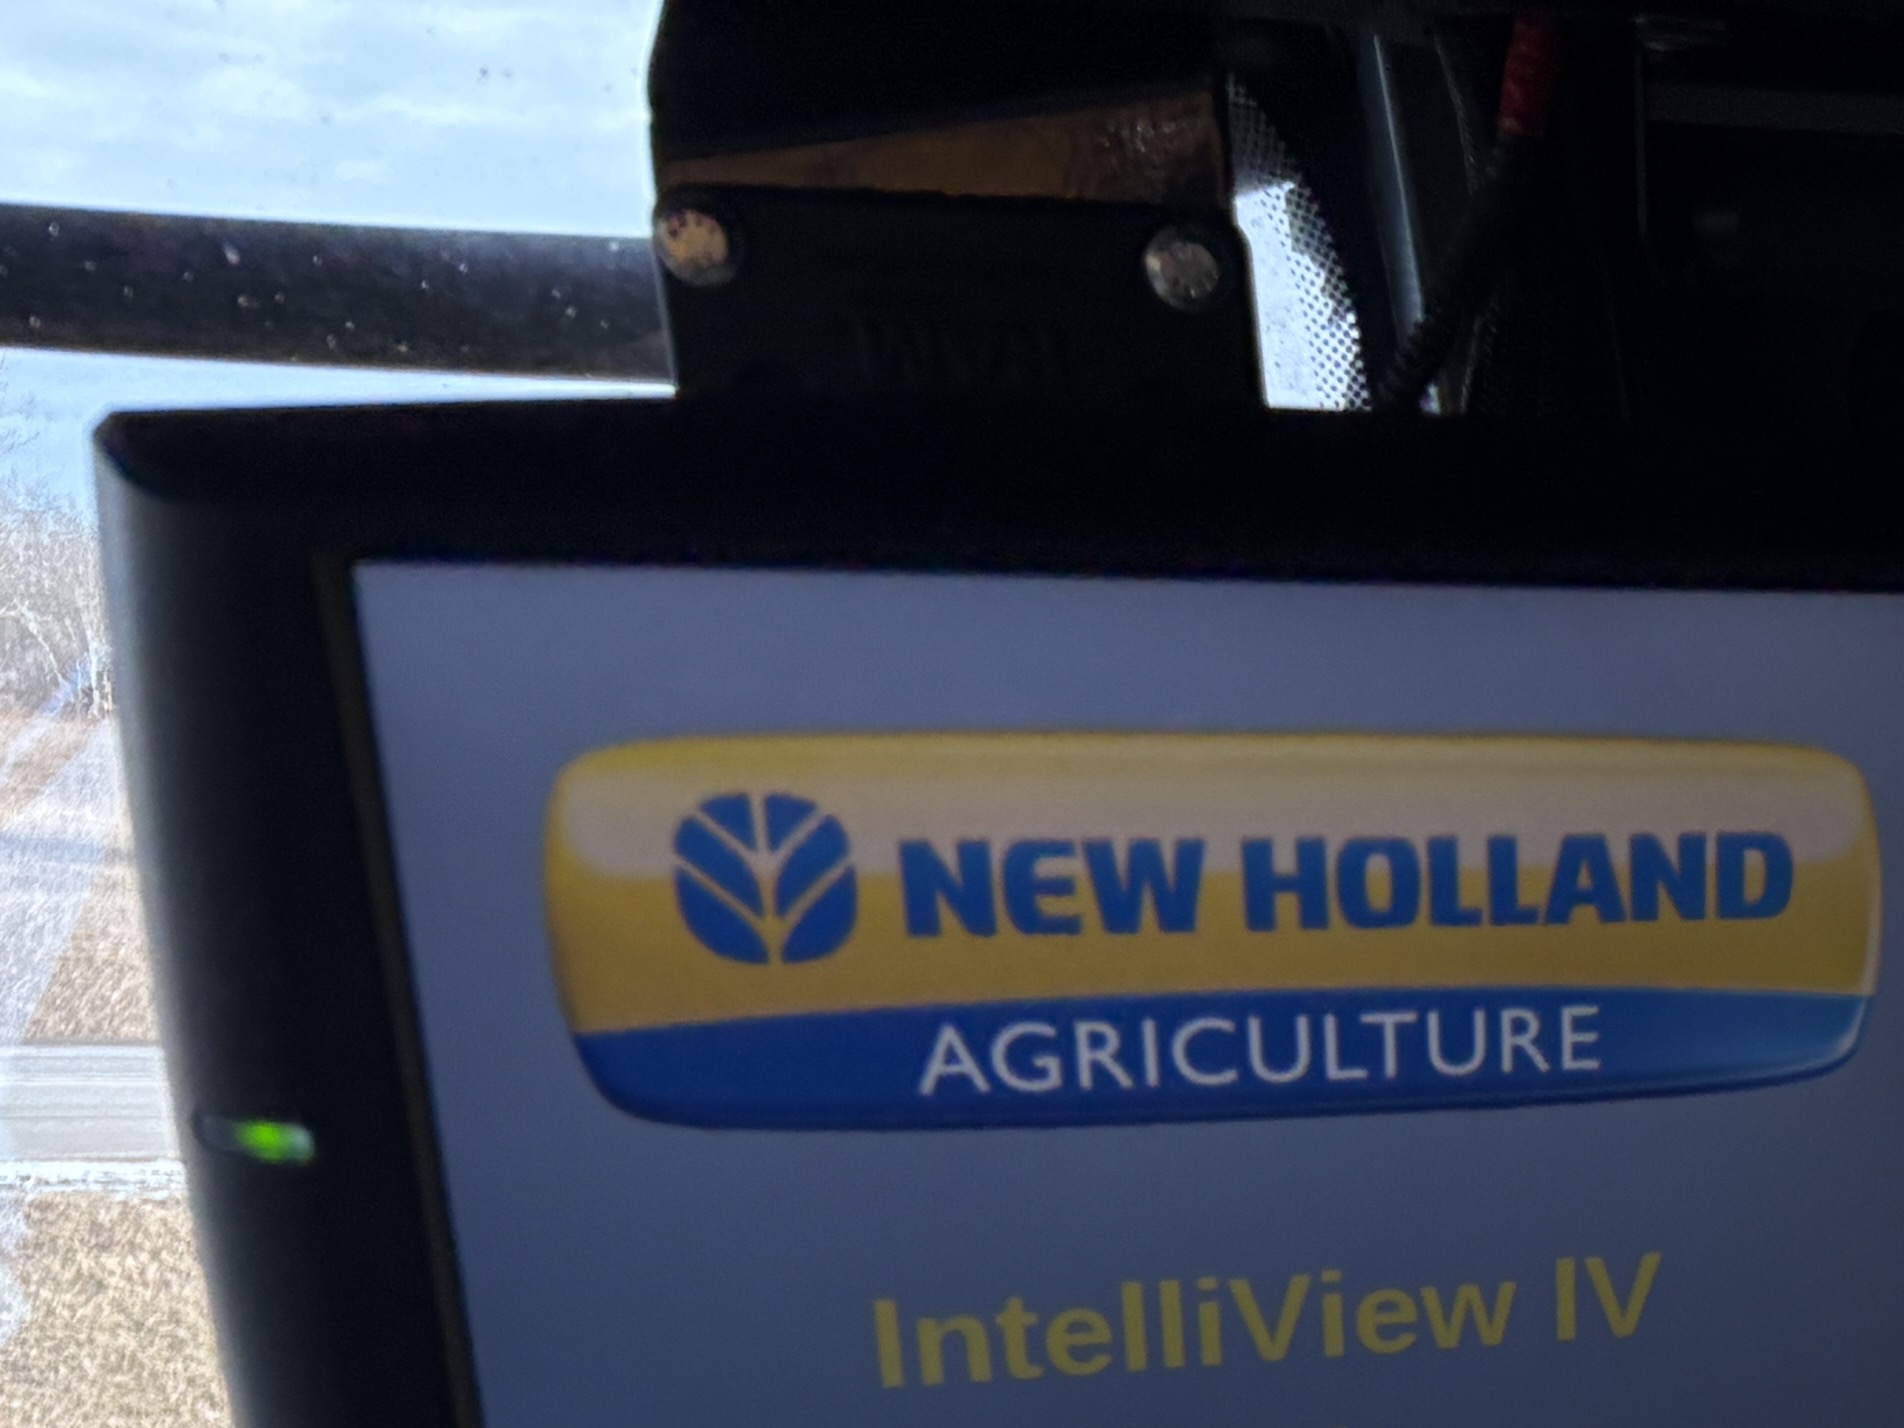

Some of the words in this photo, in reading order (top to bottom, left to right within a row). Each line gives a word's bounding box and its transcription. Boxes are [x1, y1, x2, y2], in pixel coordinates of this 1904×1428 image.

[896, 837, 1205, 939] NEW
[1238, 829, 1794, 933] HOLLAND
[917, 1003, 1601, 1097] AGRICULTURE
[872, 1269, 1518, 1389] IntelliView
[1554, 1250, 1663, 1341] IV
